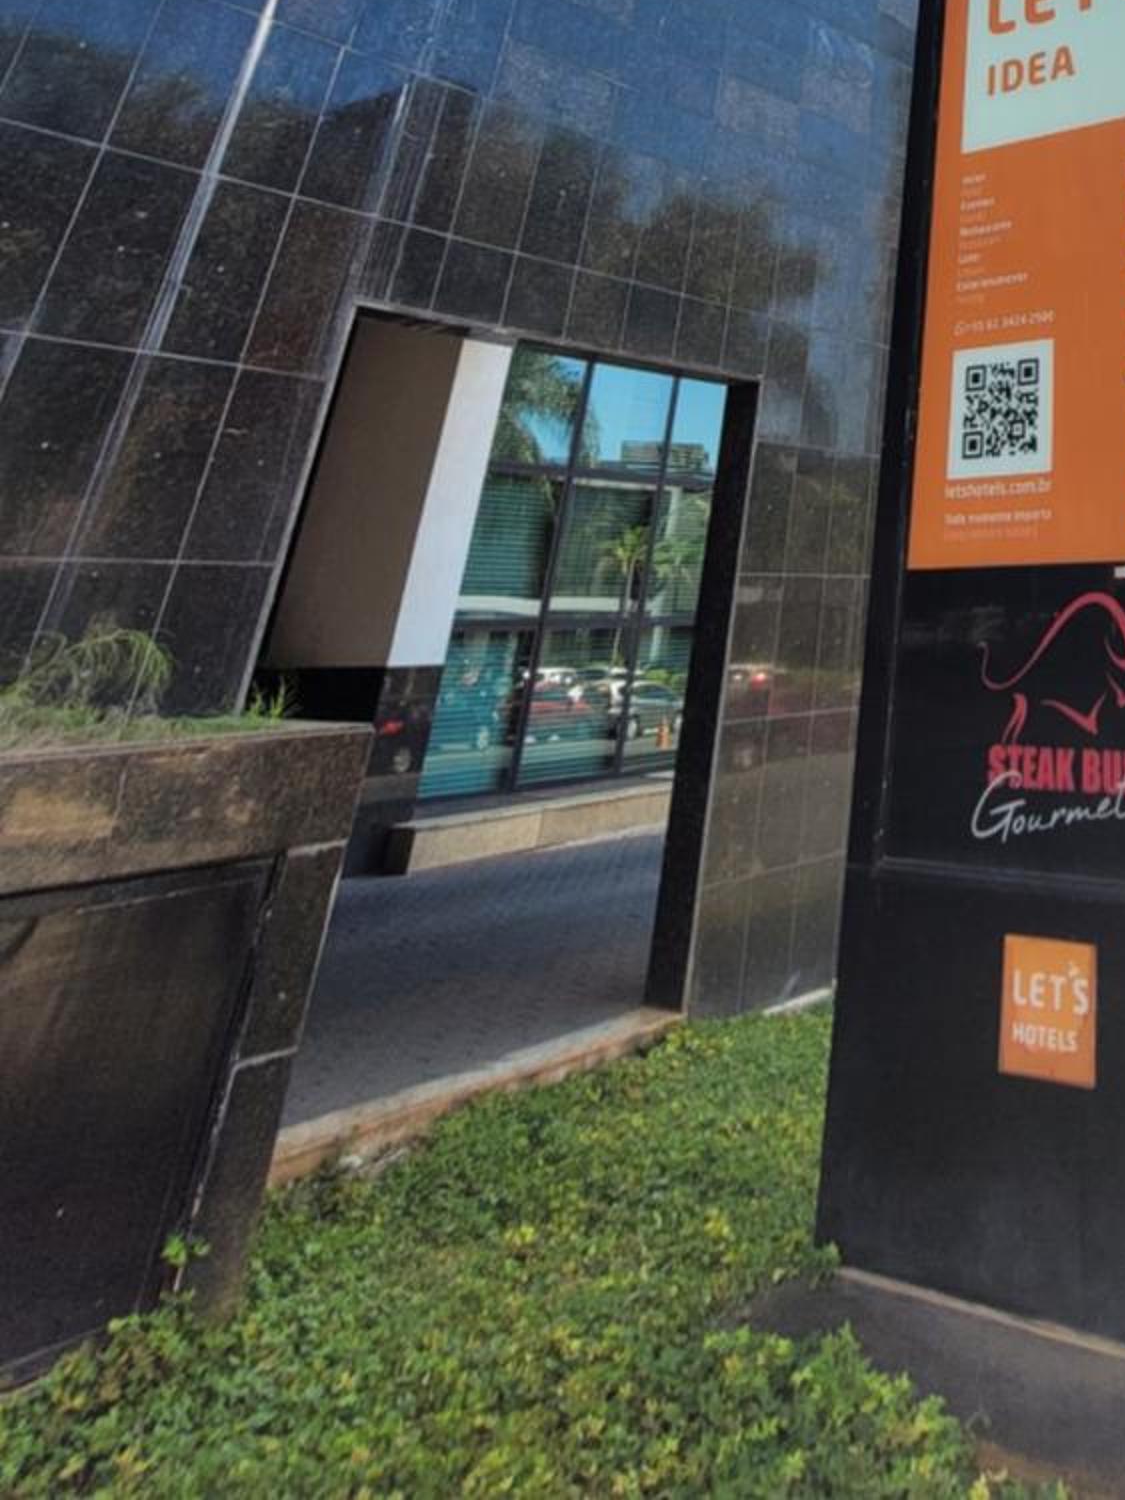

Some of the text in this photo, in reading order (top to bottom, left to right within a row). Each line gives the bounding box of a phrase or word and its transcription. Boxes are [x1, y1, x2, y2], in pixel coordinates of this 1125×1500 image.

[986, 45, 1075, 97] IDEA
[987, 744, 1075, 791] STEAK
[1011, 1020, 1080, 1053] HOTELS
